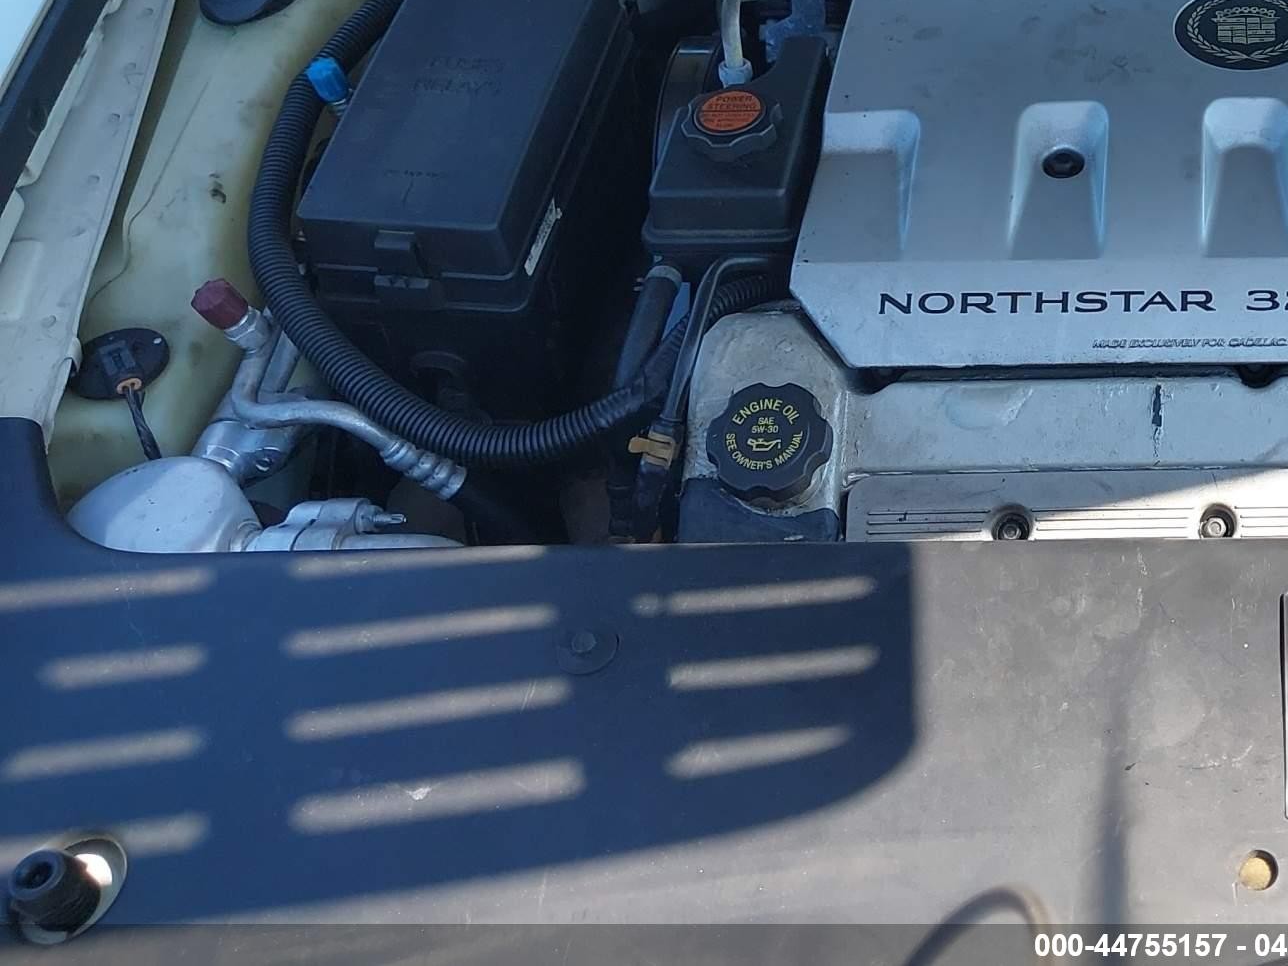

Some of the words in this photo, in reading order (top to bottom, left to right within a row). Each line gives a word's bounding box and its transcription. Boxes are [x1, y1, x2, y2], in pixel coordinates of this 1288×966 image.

[879, 290, 1216, 314] NORTHSTAR
[1092, 339, 1127, 348] MADE
[1128, 339, 1201, 348] EXCLUSIVELY
[1202, 339, 1225, 347] FOR
[1228, 338, 1287, 347] CADILLAC
[732, 399, 783, 425] ENGINE
[782, 405, 800, 425] OIL
[751, 425, 778, 433] 5W-30
[726, 433, 737, 451] SEE
[732, 450, 773, 470] OWNER'S
[775, 431, 803, 466] MANUAL
